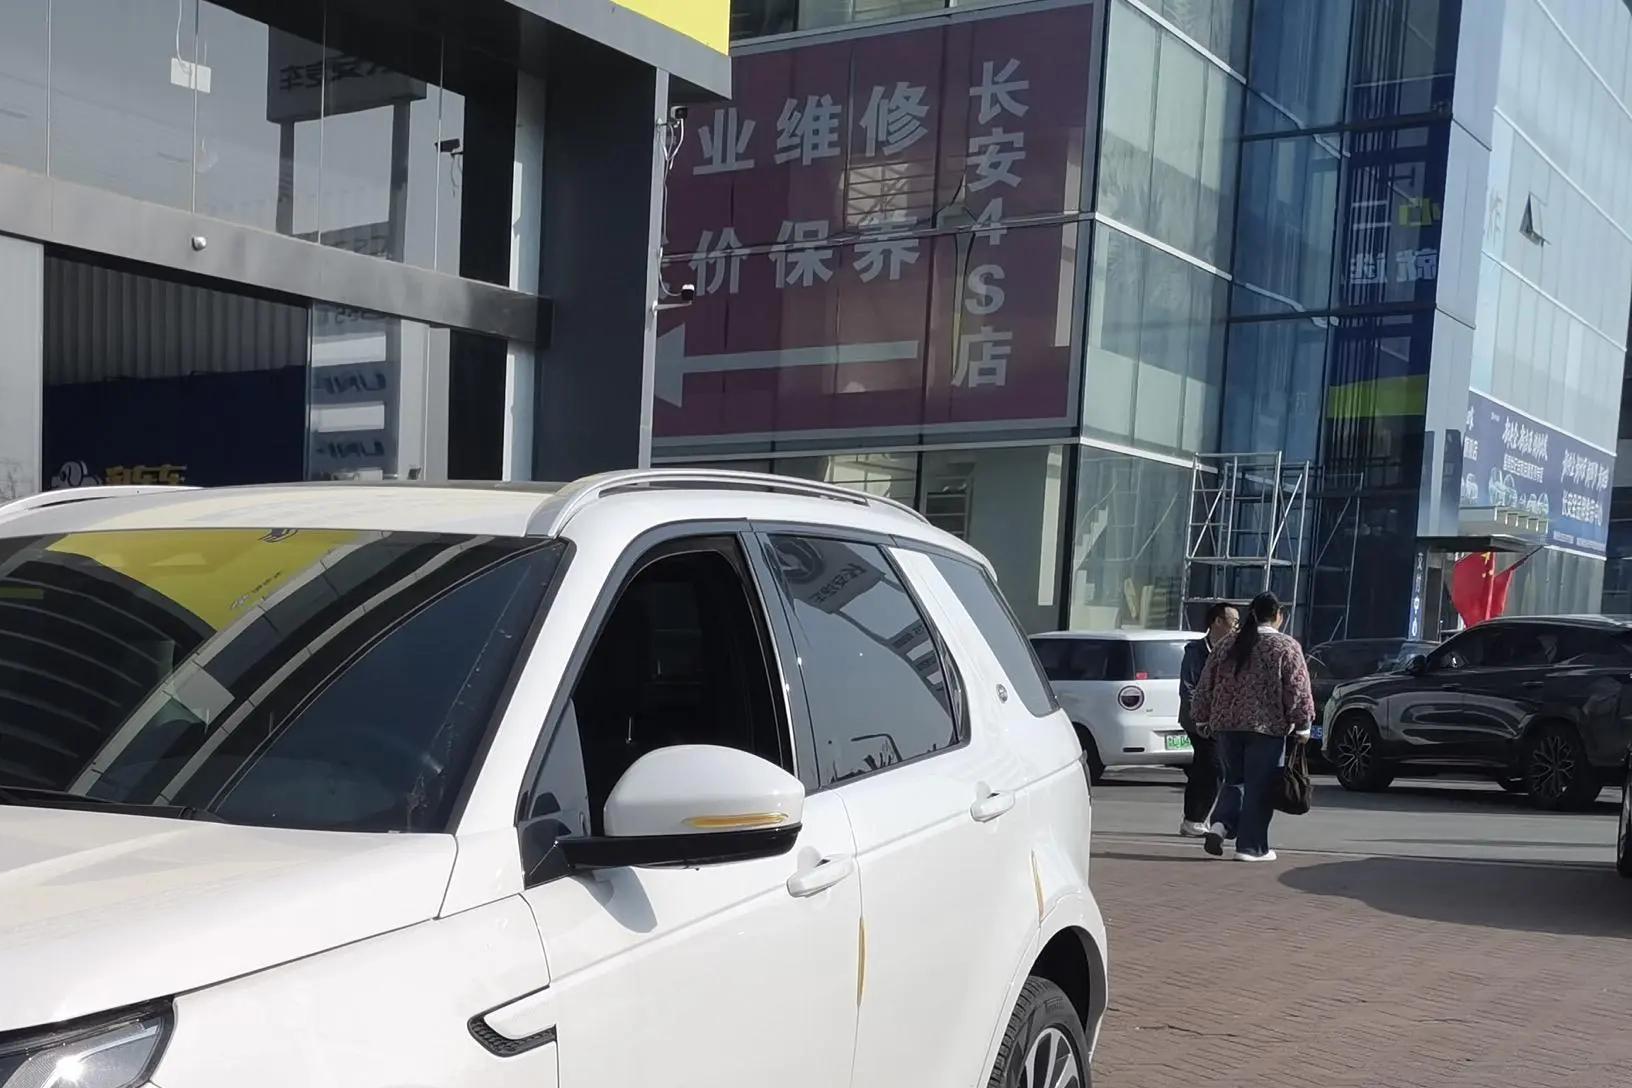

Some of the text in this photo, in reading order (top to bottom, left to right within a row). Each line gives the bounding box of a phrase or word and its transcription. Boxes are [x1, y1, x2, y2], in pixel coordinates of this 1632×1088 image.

[693, 82, 929, 175] 业维修
[661, 215, 920, 297] 价保养
[951, 59, 1029, 388] 长安4S店
